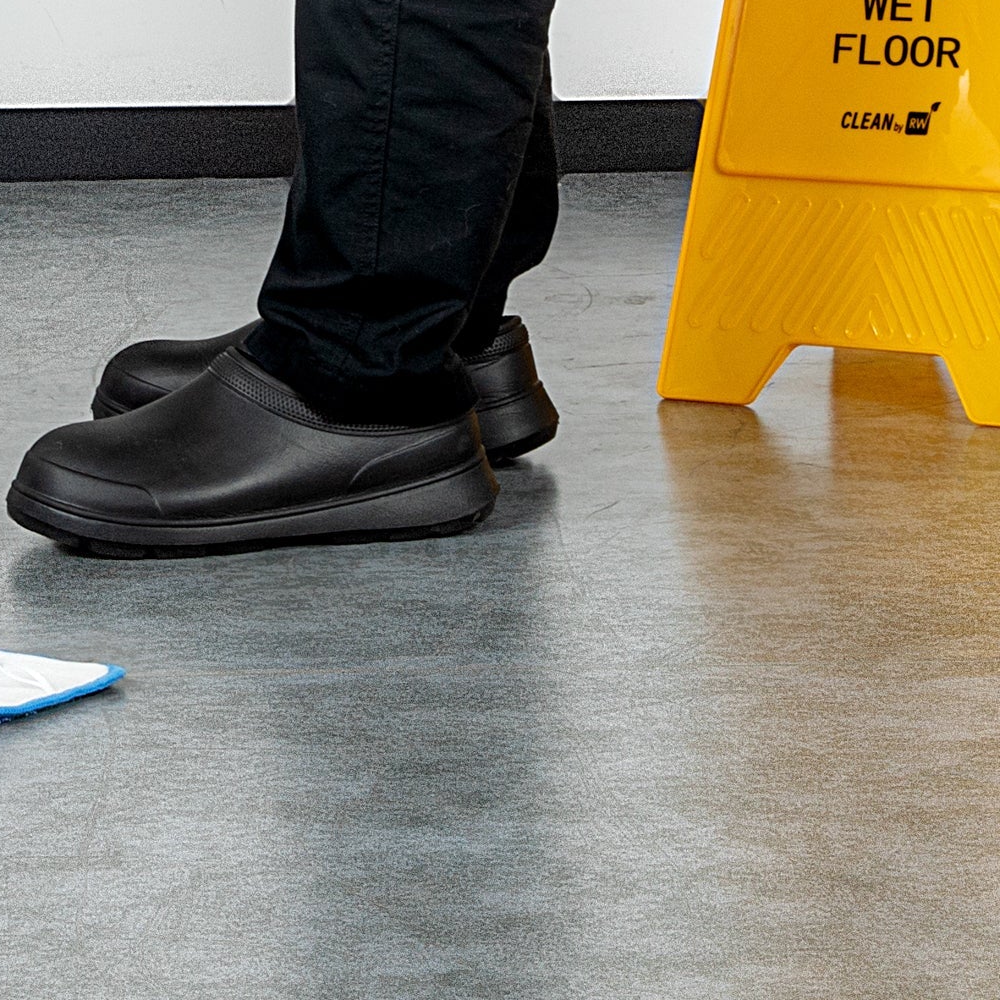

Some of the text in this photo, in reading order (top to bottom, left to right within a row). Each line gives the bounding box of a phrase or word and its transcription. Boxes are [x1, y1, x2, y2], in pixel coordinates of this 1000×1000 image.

[833, 33, 960, 68] FLOOR
[841, 111, 894, 131] CLEAN
[893, 122, 904, 134] by
